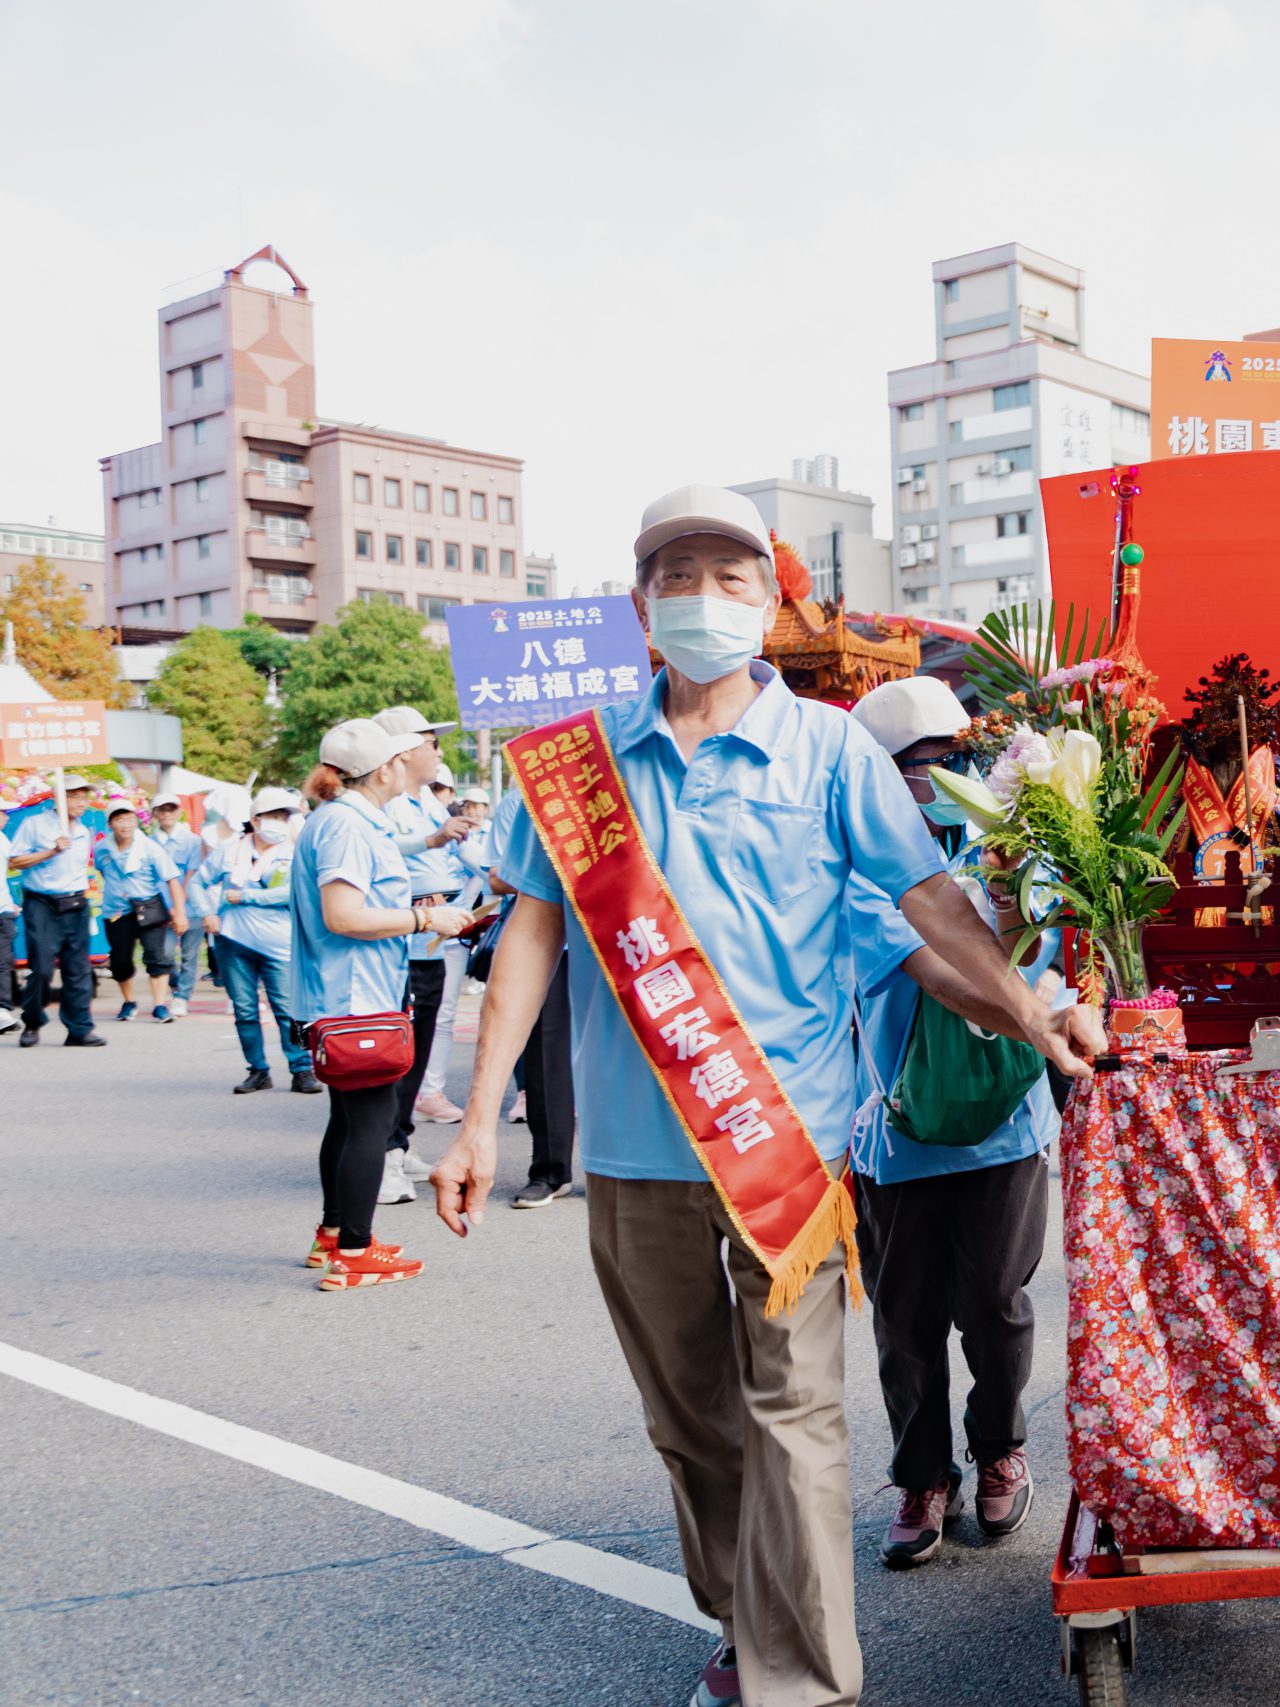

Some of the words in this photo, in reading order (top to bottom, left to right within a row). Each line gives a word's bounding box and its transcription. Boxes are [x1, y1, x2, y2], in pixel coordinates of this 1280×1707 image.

[520, 637, 587, 669] 八德
[470, 665, 640, 706] 大湳福成宮
[520, 724, 591, 771] 2025
[528, 767, 544, 781] TU
[546, 759, 561, 772] DI
[562, 742, 596, 764] GONG
[554, 774, 573, 799] FOLK
[567, 800, 586, 823] ARTS
[572, 762, 628, 856] 土地公
[1192, 786, 1220, 822] 土地公
[616, 915, 775, 1155] 桃園宏德宮
